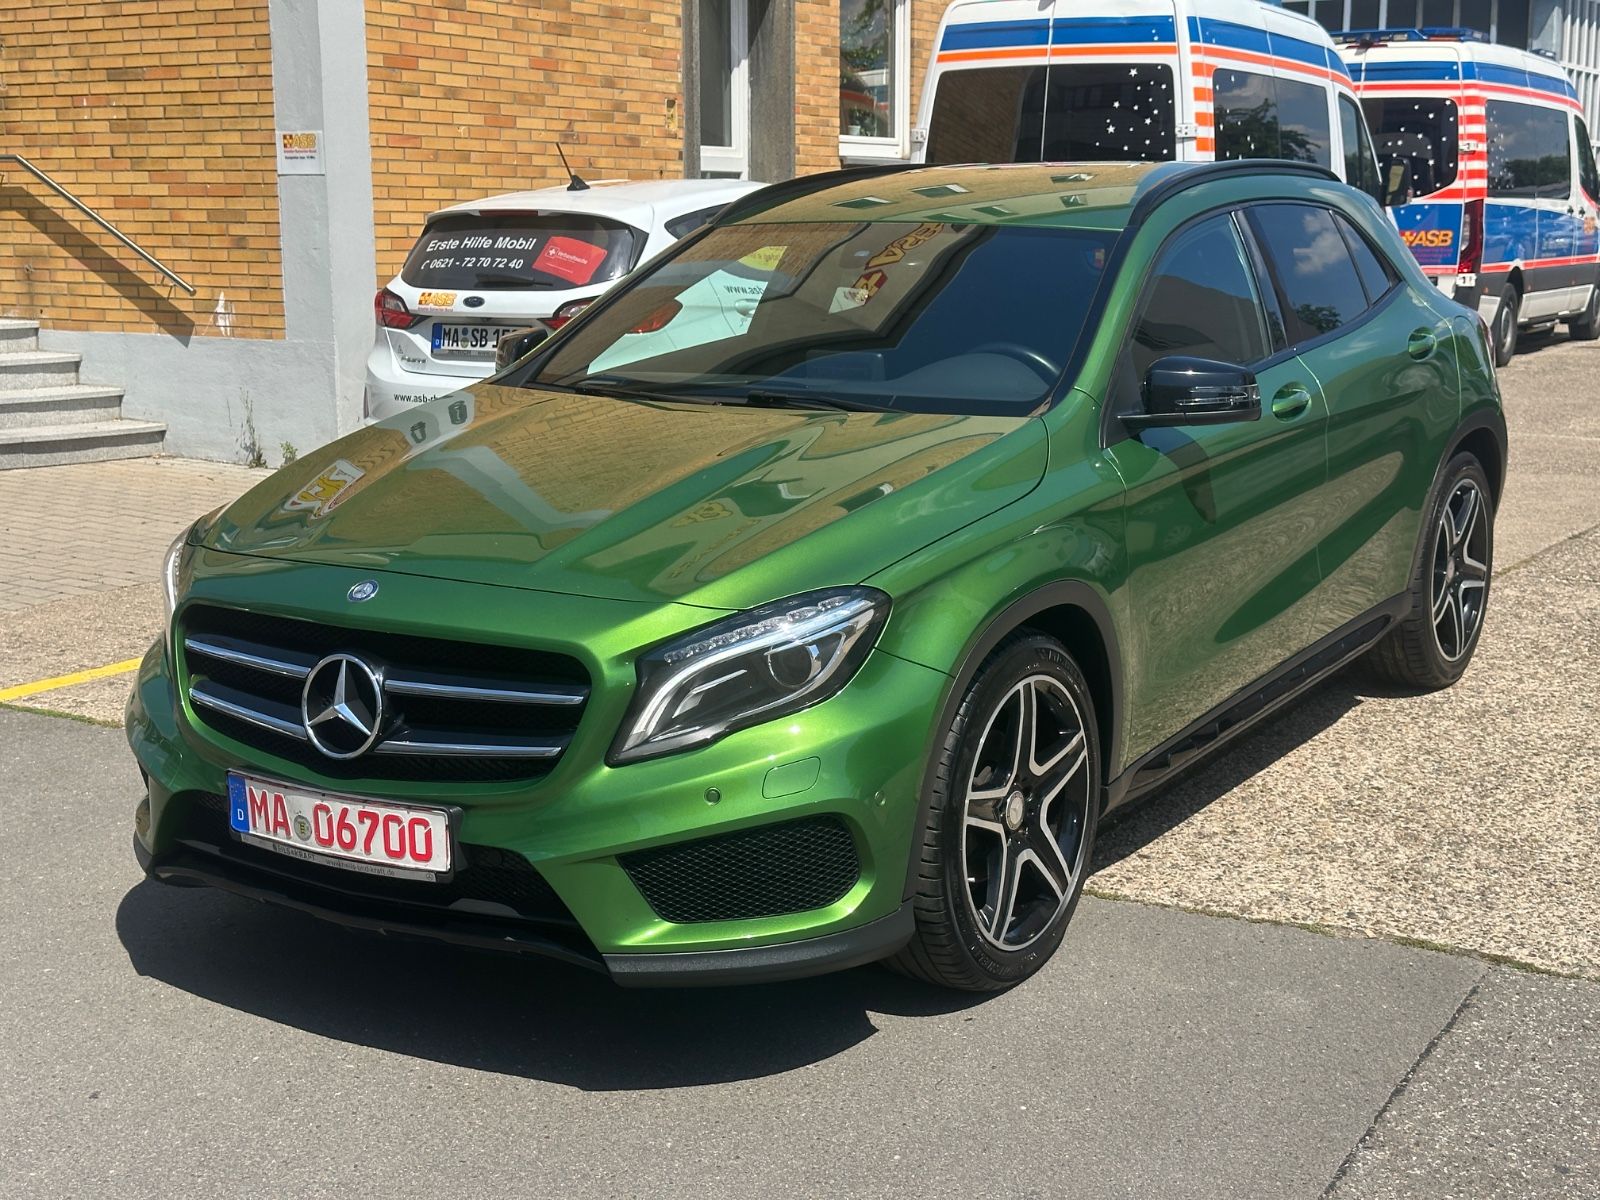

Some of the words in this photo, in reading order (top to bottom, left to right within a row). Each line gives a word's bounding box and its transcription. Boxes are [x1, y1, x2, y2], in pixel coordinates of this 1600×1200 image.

[426, 239, 460, 252] Erste
[460, 236, 493, 249] Hilfe
[494, 236, 537, 250] Mobil
[1411, 229, 1454, 247] ASB
[429, 257, 454, 269] 0621
[461, 257, 476, 267] 72
[476, 257, 491, 267] 70
[492, 257, 508, 268] 72
[508, 259, 524, 269] 40
[442, 327, 459, 347] MA
[470, 328, 488, 348] SB
[237, 808, 244, 821] D
[249, 785, 293, 839] MA
[312, 801, 433, 863] 06700
